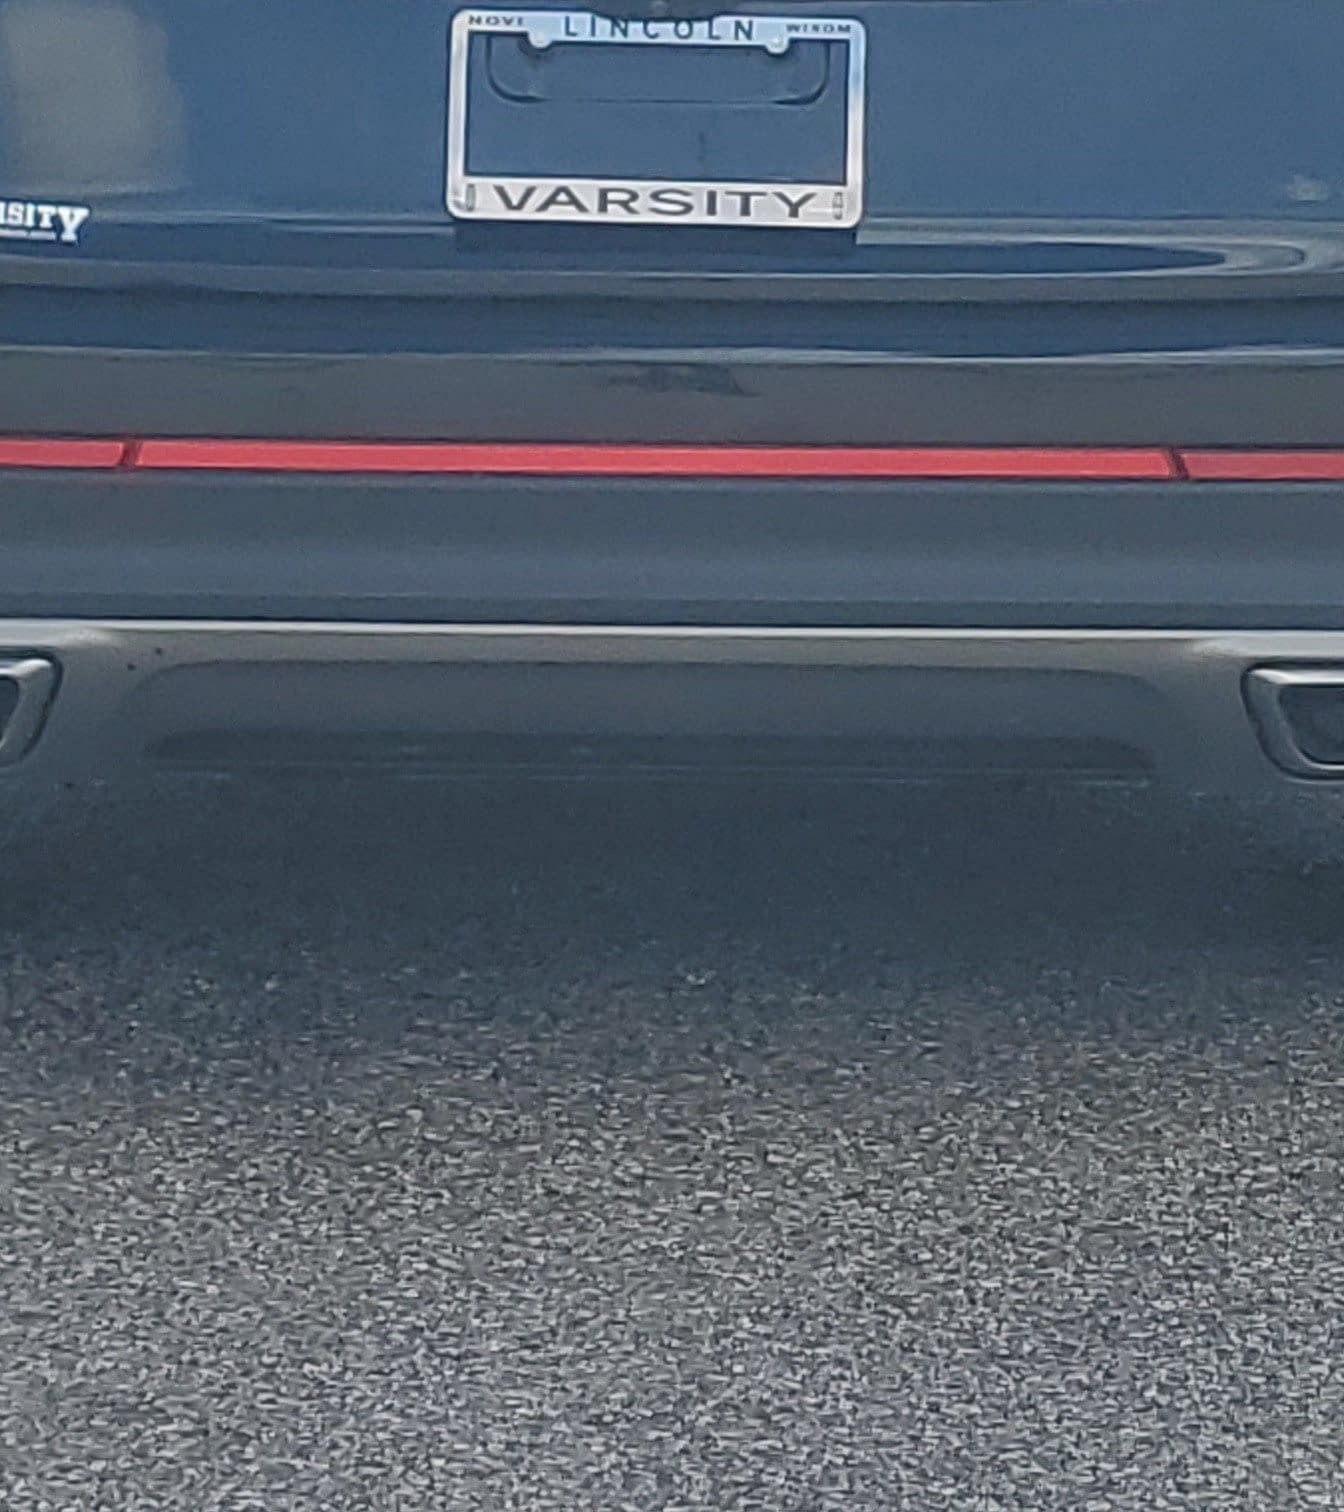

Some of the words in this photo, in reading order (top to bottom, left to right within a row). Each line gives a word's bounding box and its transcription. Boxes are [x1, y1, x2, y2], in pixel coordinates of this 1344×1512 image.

[468, 14, 523, 26] NOVI
[563, 14, 755, 41] LINCOLN
[493, 184, 817, 219] VARSITY
